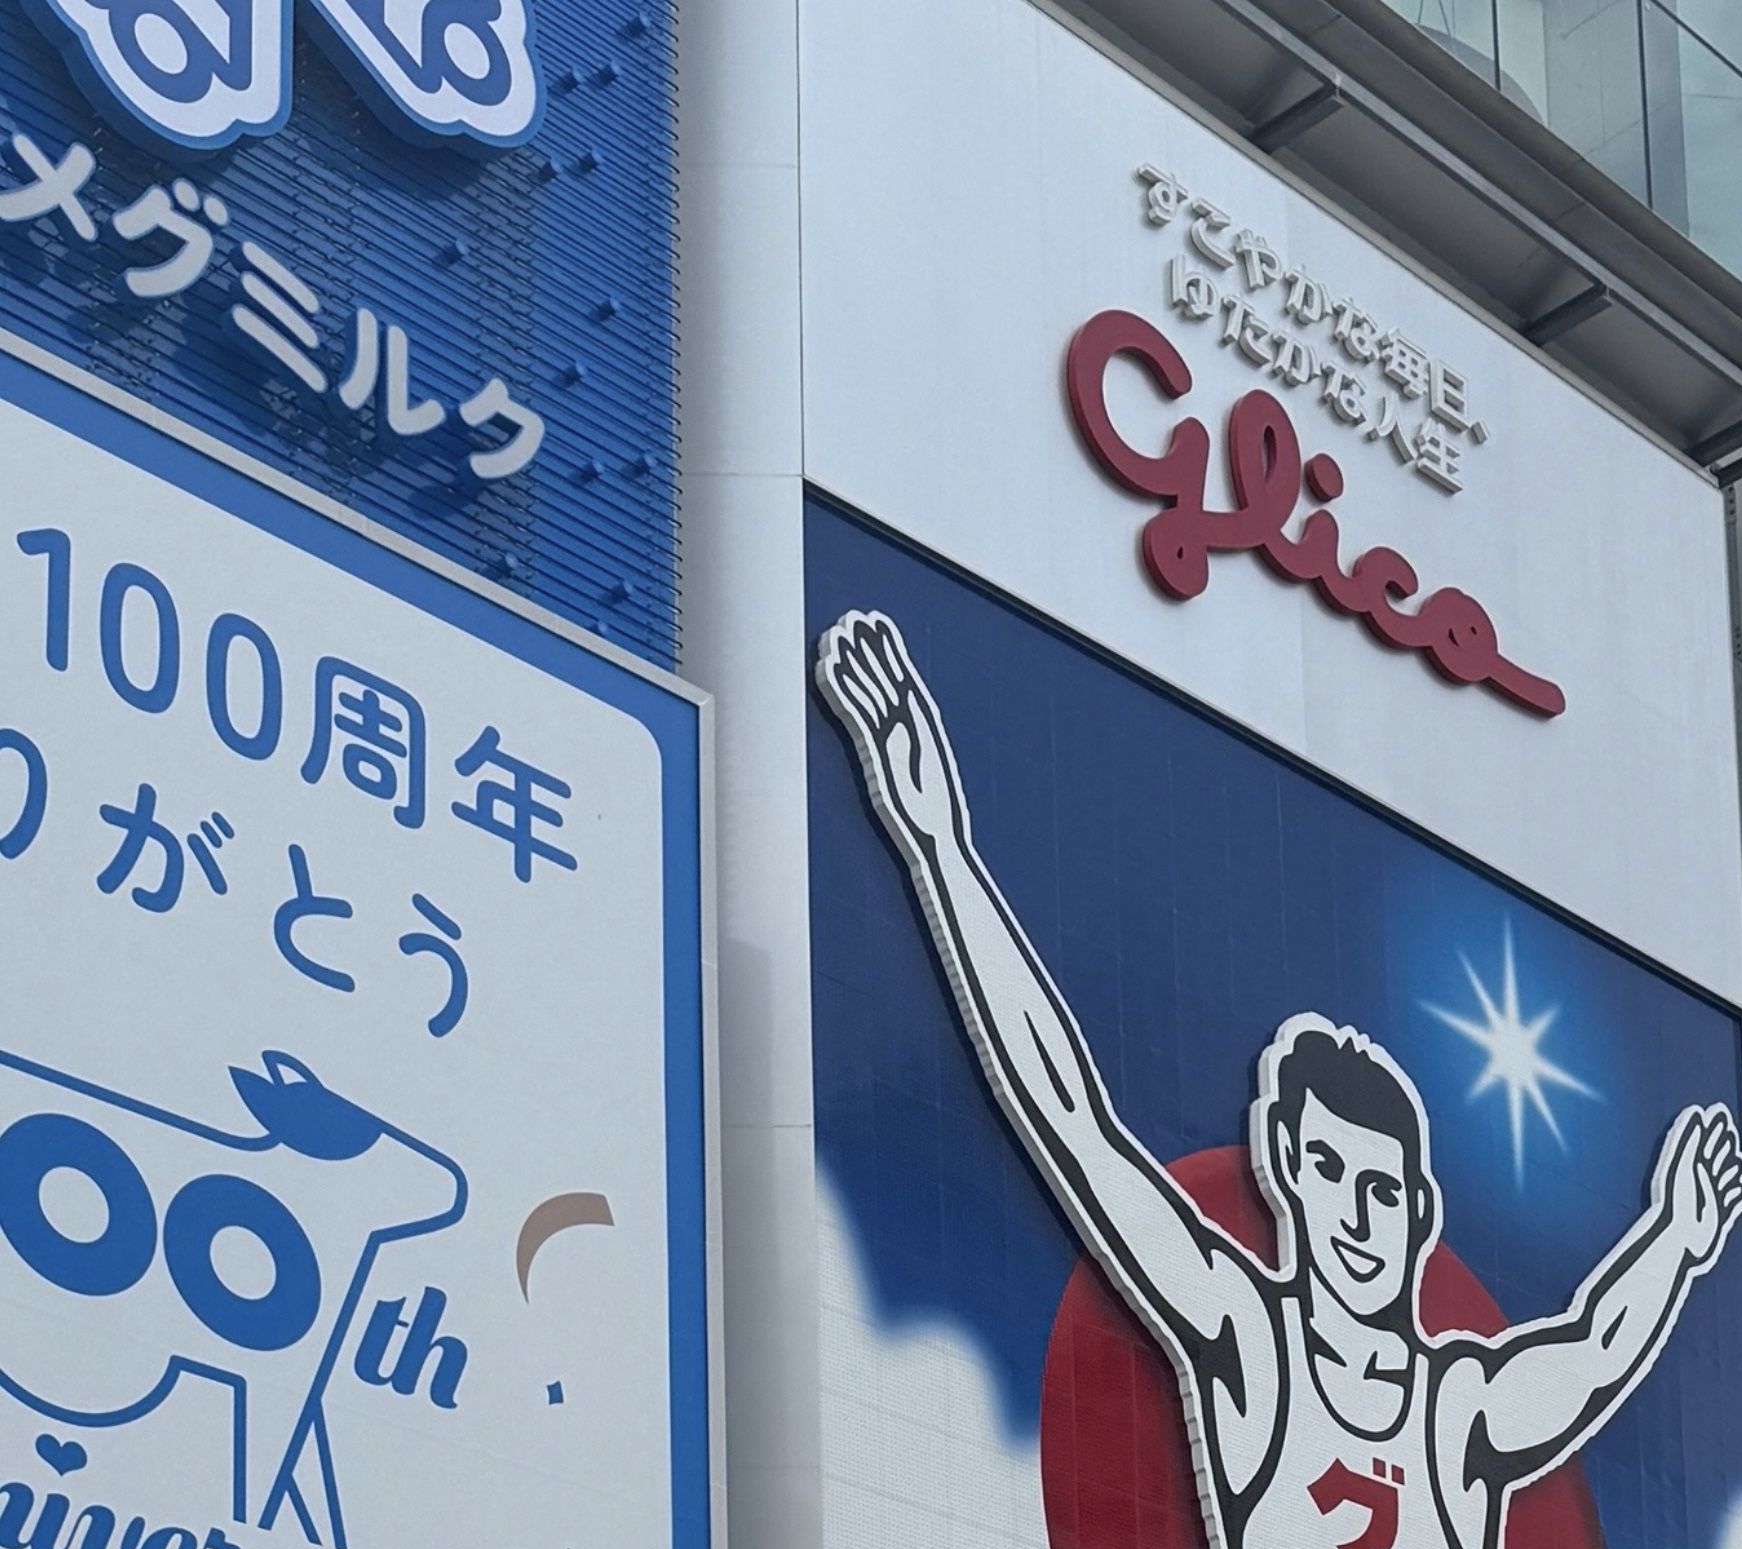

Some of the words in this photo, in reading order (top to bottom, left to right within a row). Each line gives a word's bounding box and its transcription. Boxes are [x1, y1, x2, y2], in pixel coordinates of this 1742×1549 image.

[0, 132, 545, 480] メグミルク
[1168, 254, 1464, 496] ゆたかな人生
[1067, 309, 1566, 718] Glico
[16, 528, 578, 884] 100周年
